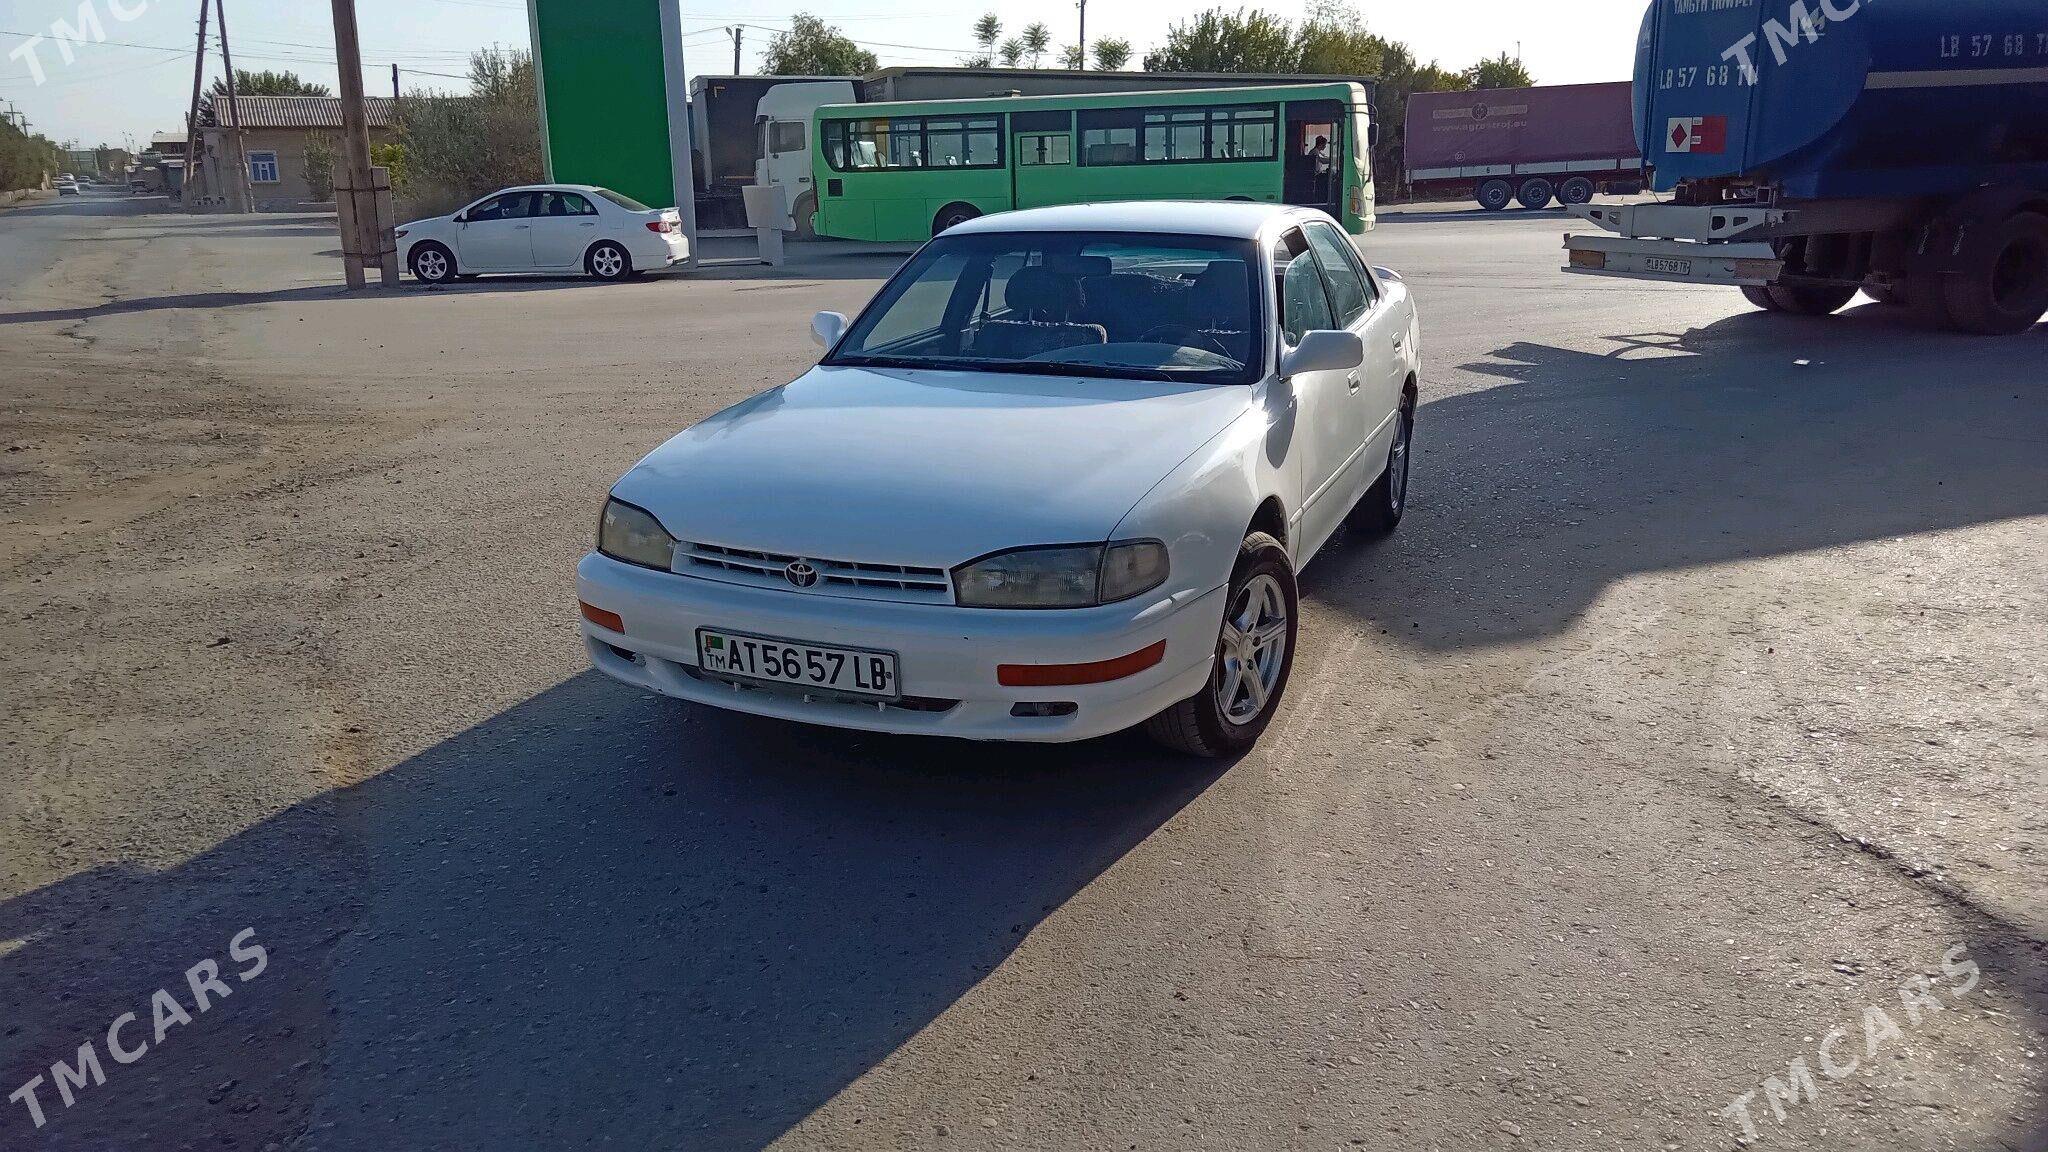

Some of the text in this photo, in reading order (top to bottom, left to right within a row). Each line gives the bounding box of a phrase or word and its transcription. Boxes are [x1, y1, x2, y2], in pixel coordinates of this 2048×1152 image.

[1971, 34, 1993, 56] 57
[1677, 66, 1698, 88] 57
[1706, 64, 1729, 86] 68
